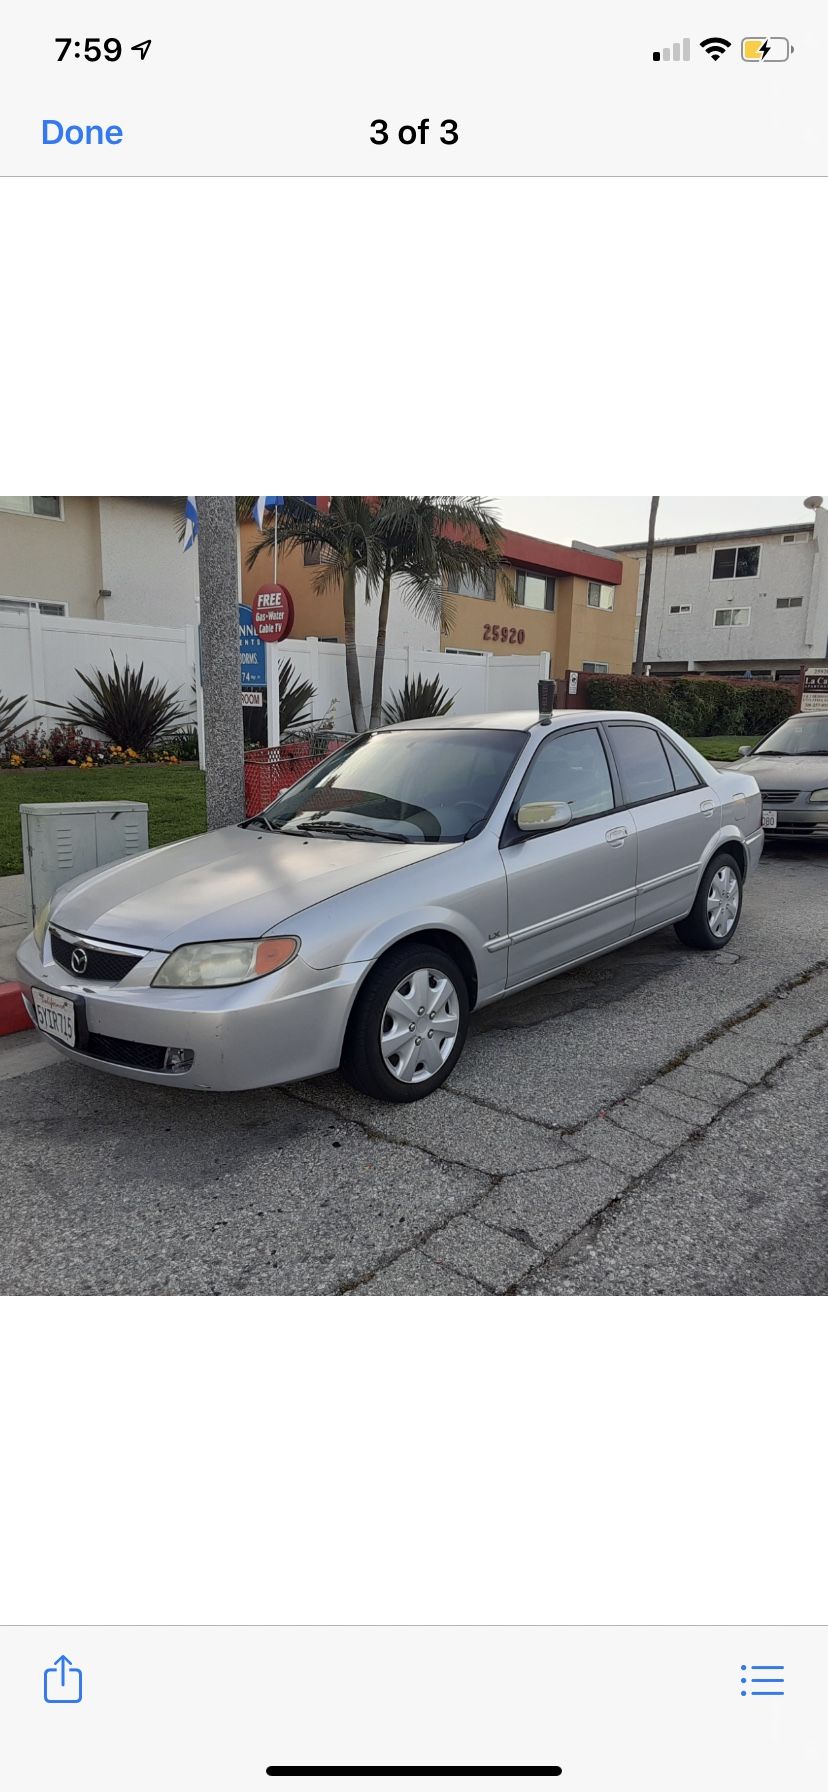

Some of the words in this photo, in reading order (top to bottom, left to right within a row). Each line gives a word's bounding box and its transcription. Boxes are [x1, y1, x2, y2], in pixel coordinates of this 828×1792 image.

[257, 592, 282, 607] FREE
[258, 624, 274, 634] Cable
[274, 622, 283, 633] TV
[482, 623, 526, 645] 25920
[488, 930, 501, 940] LX
